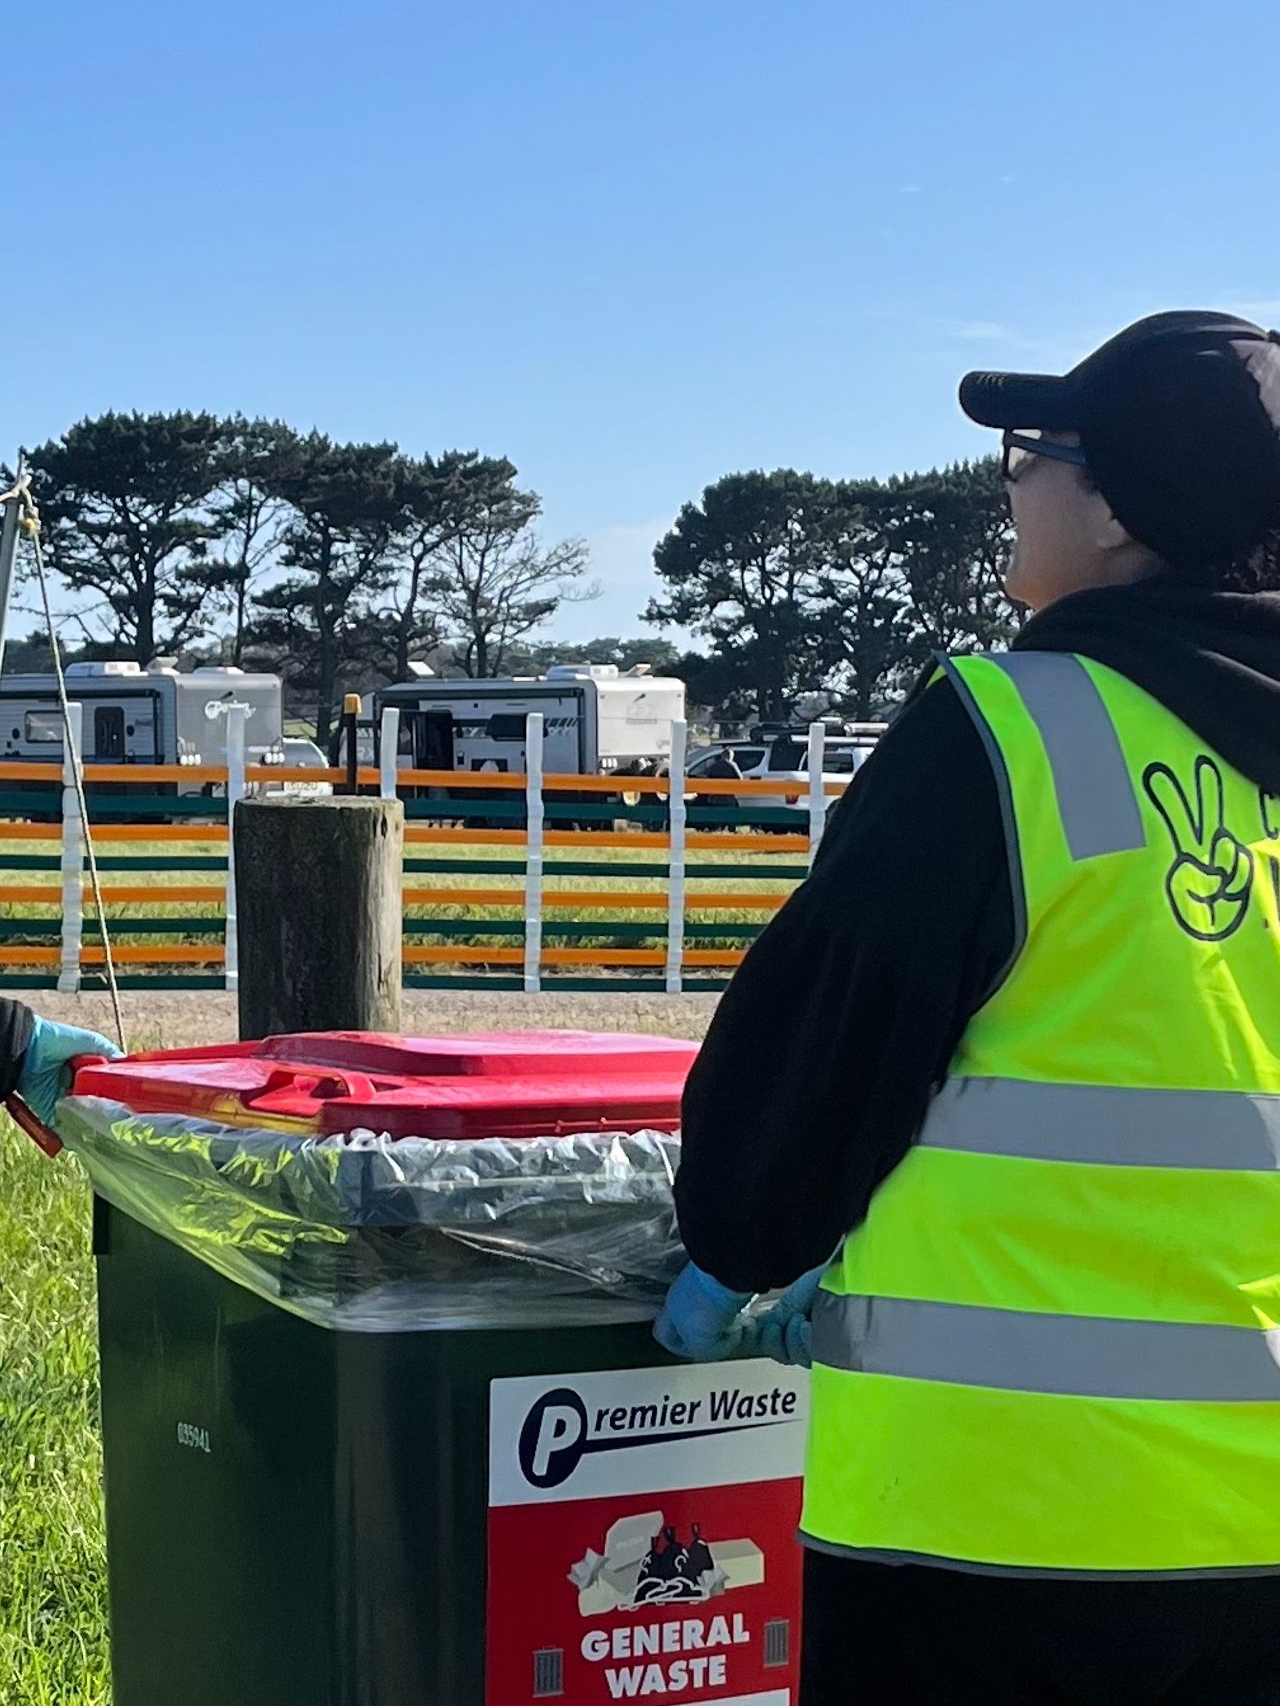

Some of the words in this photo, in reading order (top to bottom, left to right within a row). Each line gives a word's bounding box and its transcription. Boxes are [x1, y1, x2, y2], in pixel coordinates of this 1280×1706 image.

[532, 1395, 702, 1477] Premier
[710, 1388, 797, 1422] Waste
[581, 1613, 750, 1662] GENERAL
[605, 1654, 727, 1698] WASTE
